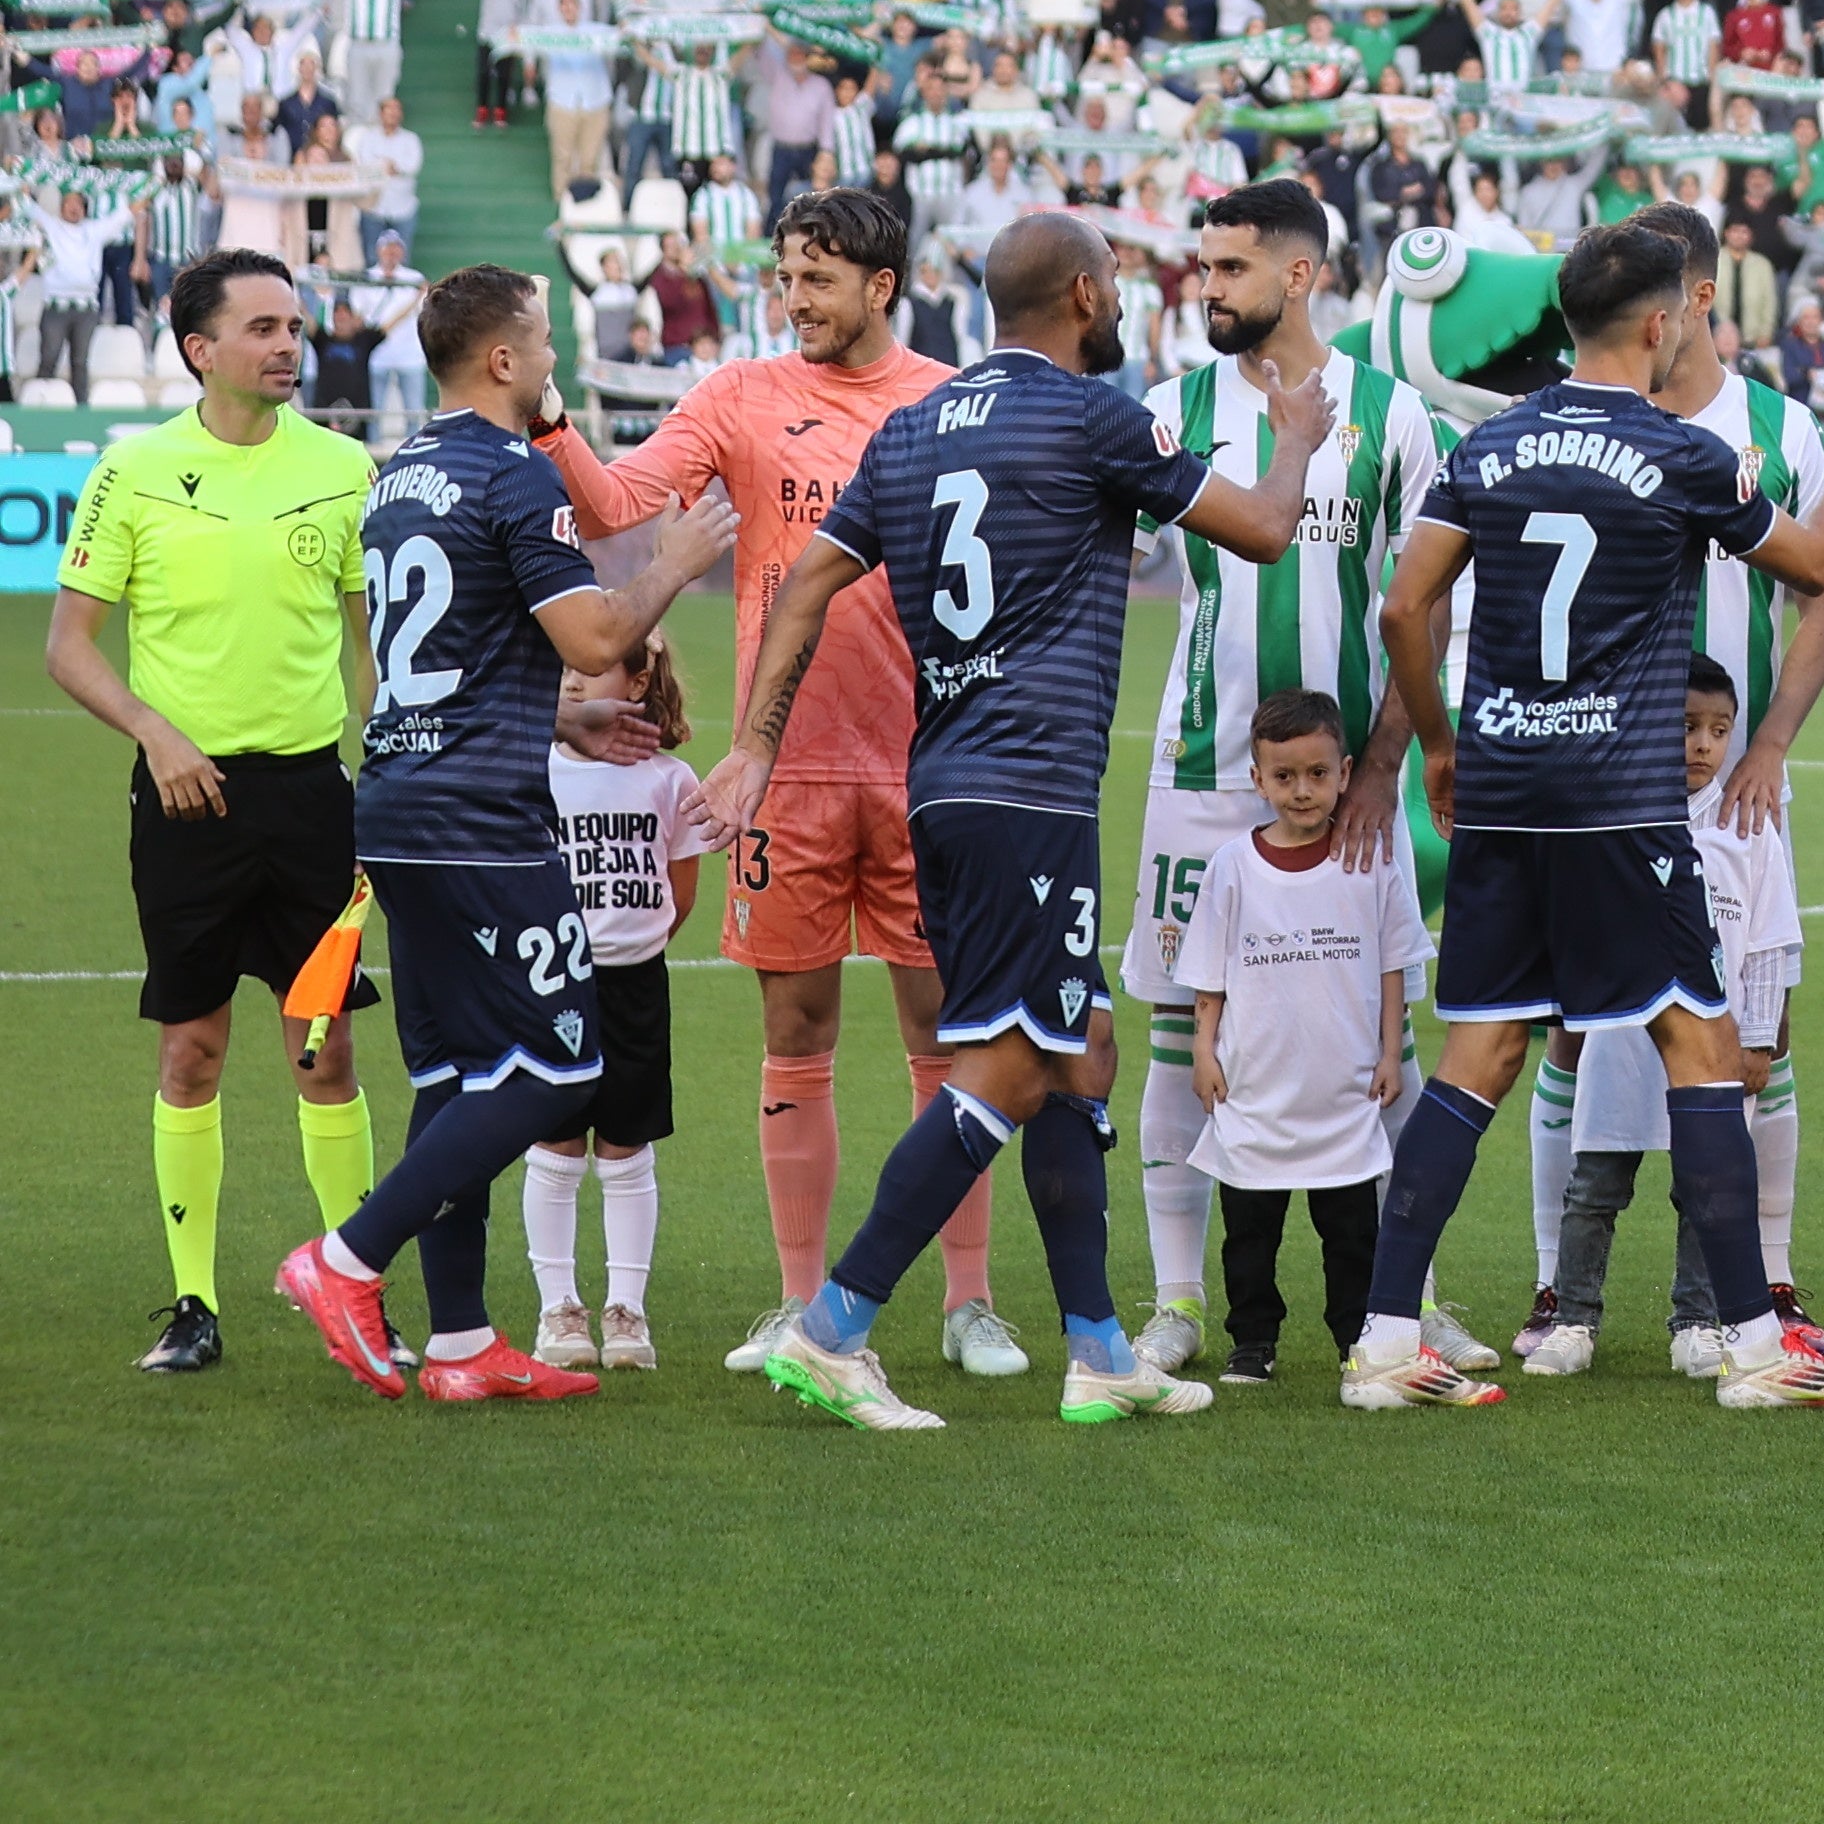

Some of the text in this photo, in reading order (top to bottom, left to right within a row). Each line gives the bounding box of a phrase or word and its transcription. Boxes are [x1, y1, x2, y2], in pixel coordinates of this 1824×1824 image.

[935, 392, 998, 435] FALI
[1478, 429, 1664, 500] R. SOBRINO
[80, 467, 119, 543] WÜRTH
[931, 468, 995, 642] 3
[1202, 588, 1217, 672] HUMANIDAD
[1520, 511, 1598, 683] 7
[1192, 596, 1209, 672] PATRIMONIO
[1192, 671, 1205, 729] CÓRDOBA
[1513, 713, 1619, 738] PASCUAL
[573, 812, 659, 848] EQUIPO
[576, 846, 658, 877] DEJA A
[1064, 886, 1096, 958] 3
[1152, 852, 1207, 923] 15
[516, 912, 592, 997] 22
[1243, 947, 1361, 968] SAN RAFAEL MOTOR
[1311, 928, 1335, 937] BMW
[1311, 936, 1361, 946] MOTORRAD
